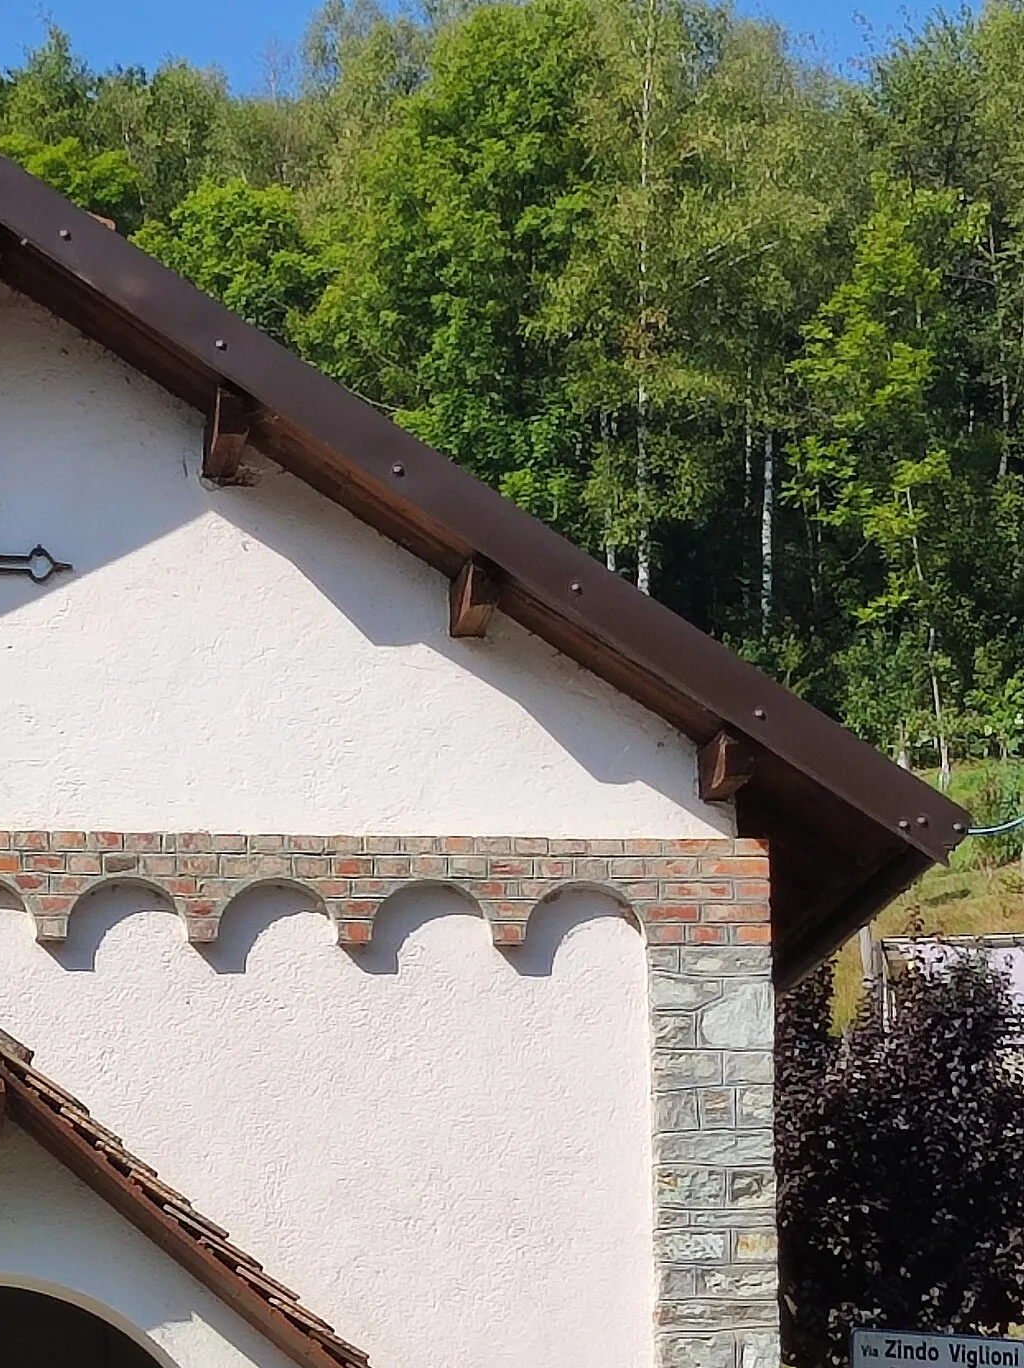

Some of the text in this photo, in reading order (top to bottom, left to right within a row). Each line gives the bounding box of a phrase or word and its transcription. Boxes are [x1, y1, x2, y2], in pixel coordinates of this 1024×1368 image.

[860, 1339, 1019, 1368] Via Zindo Viglioni
